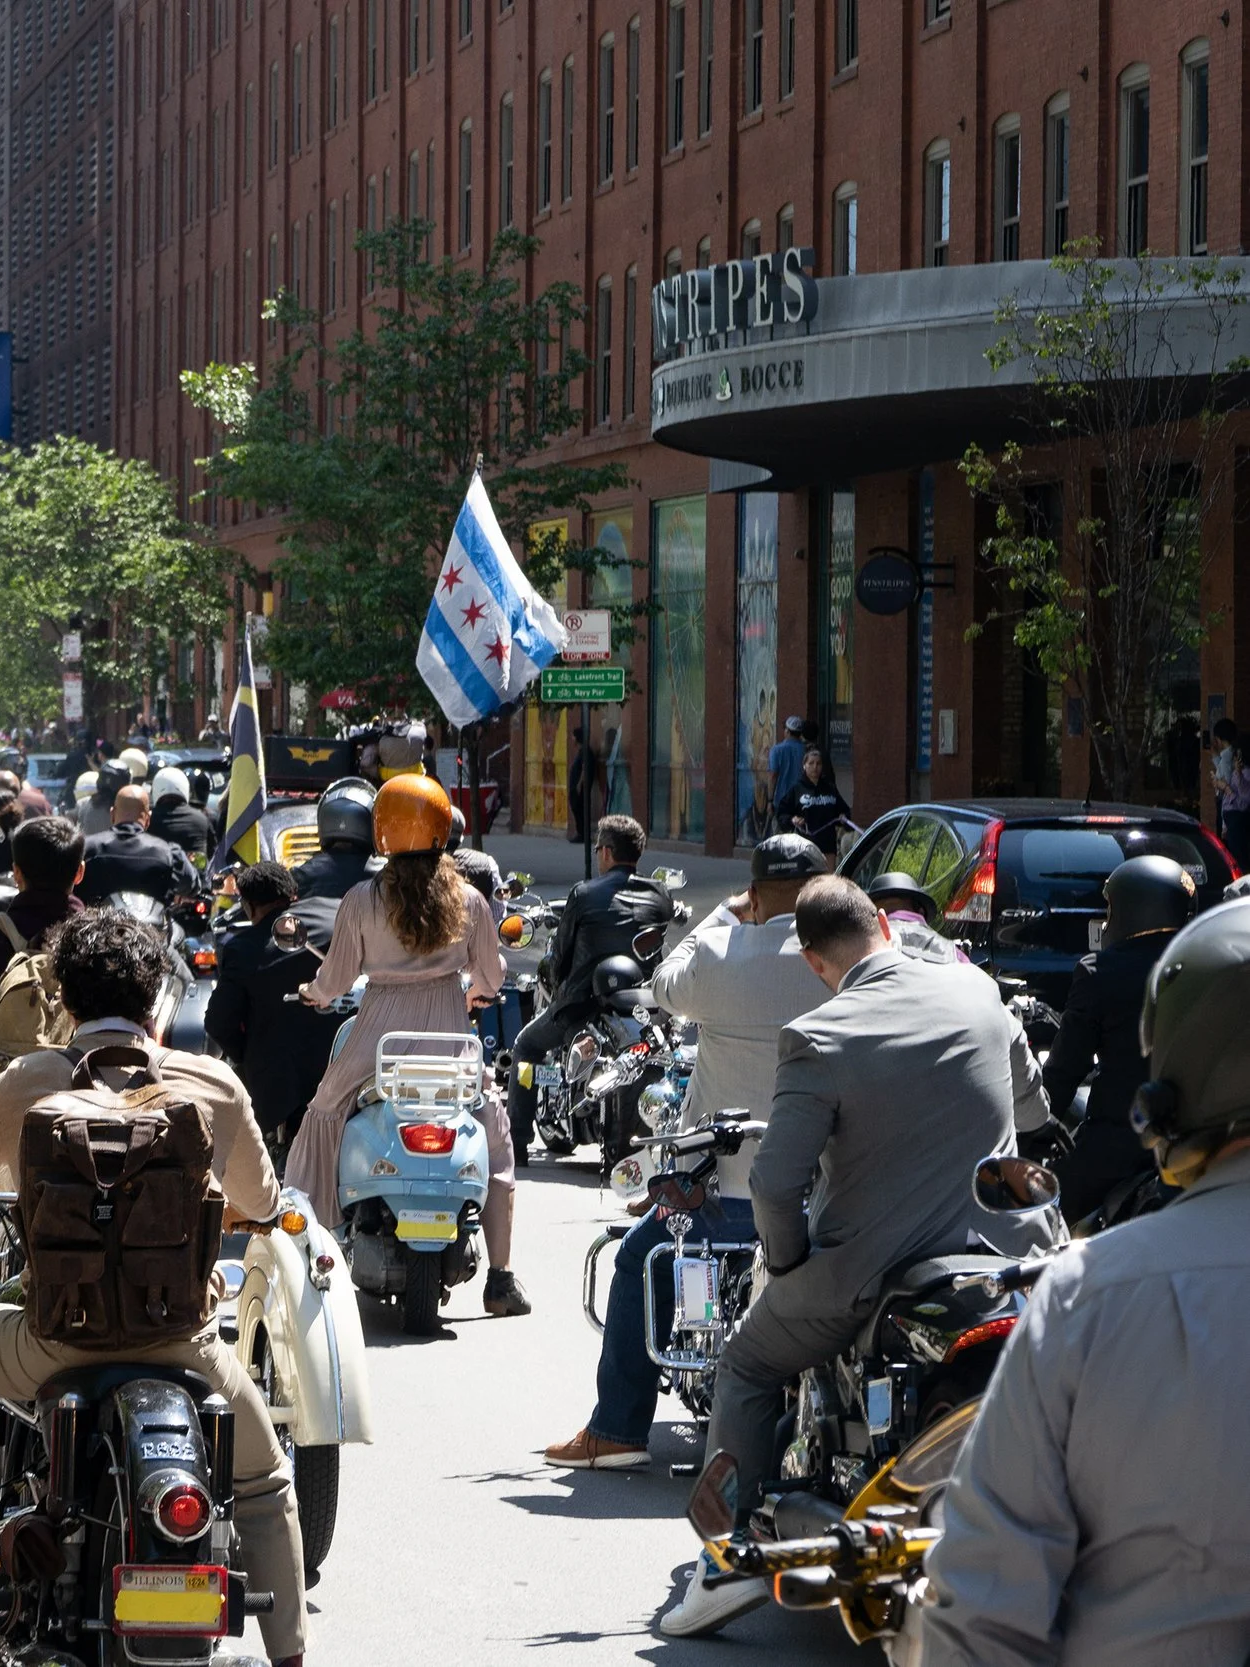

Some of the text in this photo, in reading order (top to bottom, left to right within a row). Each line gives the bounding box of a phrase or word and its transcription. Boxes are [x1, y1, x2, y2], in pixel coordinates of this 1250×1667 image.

[666, 359, 805, 408] BOWLING BOCCE
[831, 540, 853, 564] LOOKS
[830, 575, 851, 599] GOOD
[830, 605, 842, 627] ON
[830, 634, 846, 657] YOU
[574, 672, 621, 681] Lakefront Trail
[574, 688, 606, 698] Navy Pier
[134, 1574, 184, 1586] ILLINOIS
